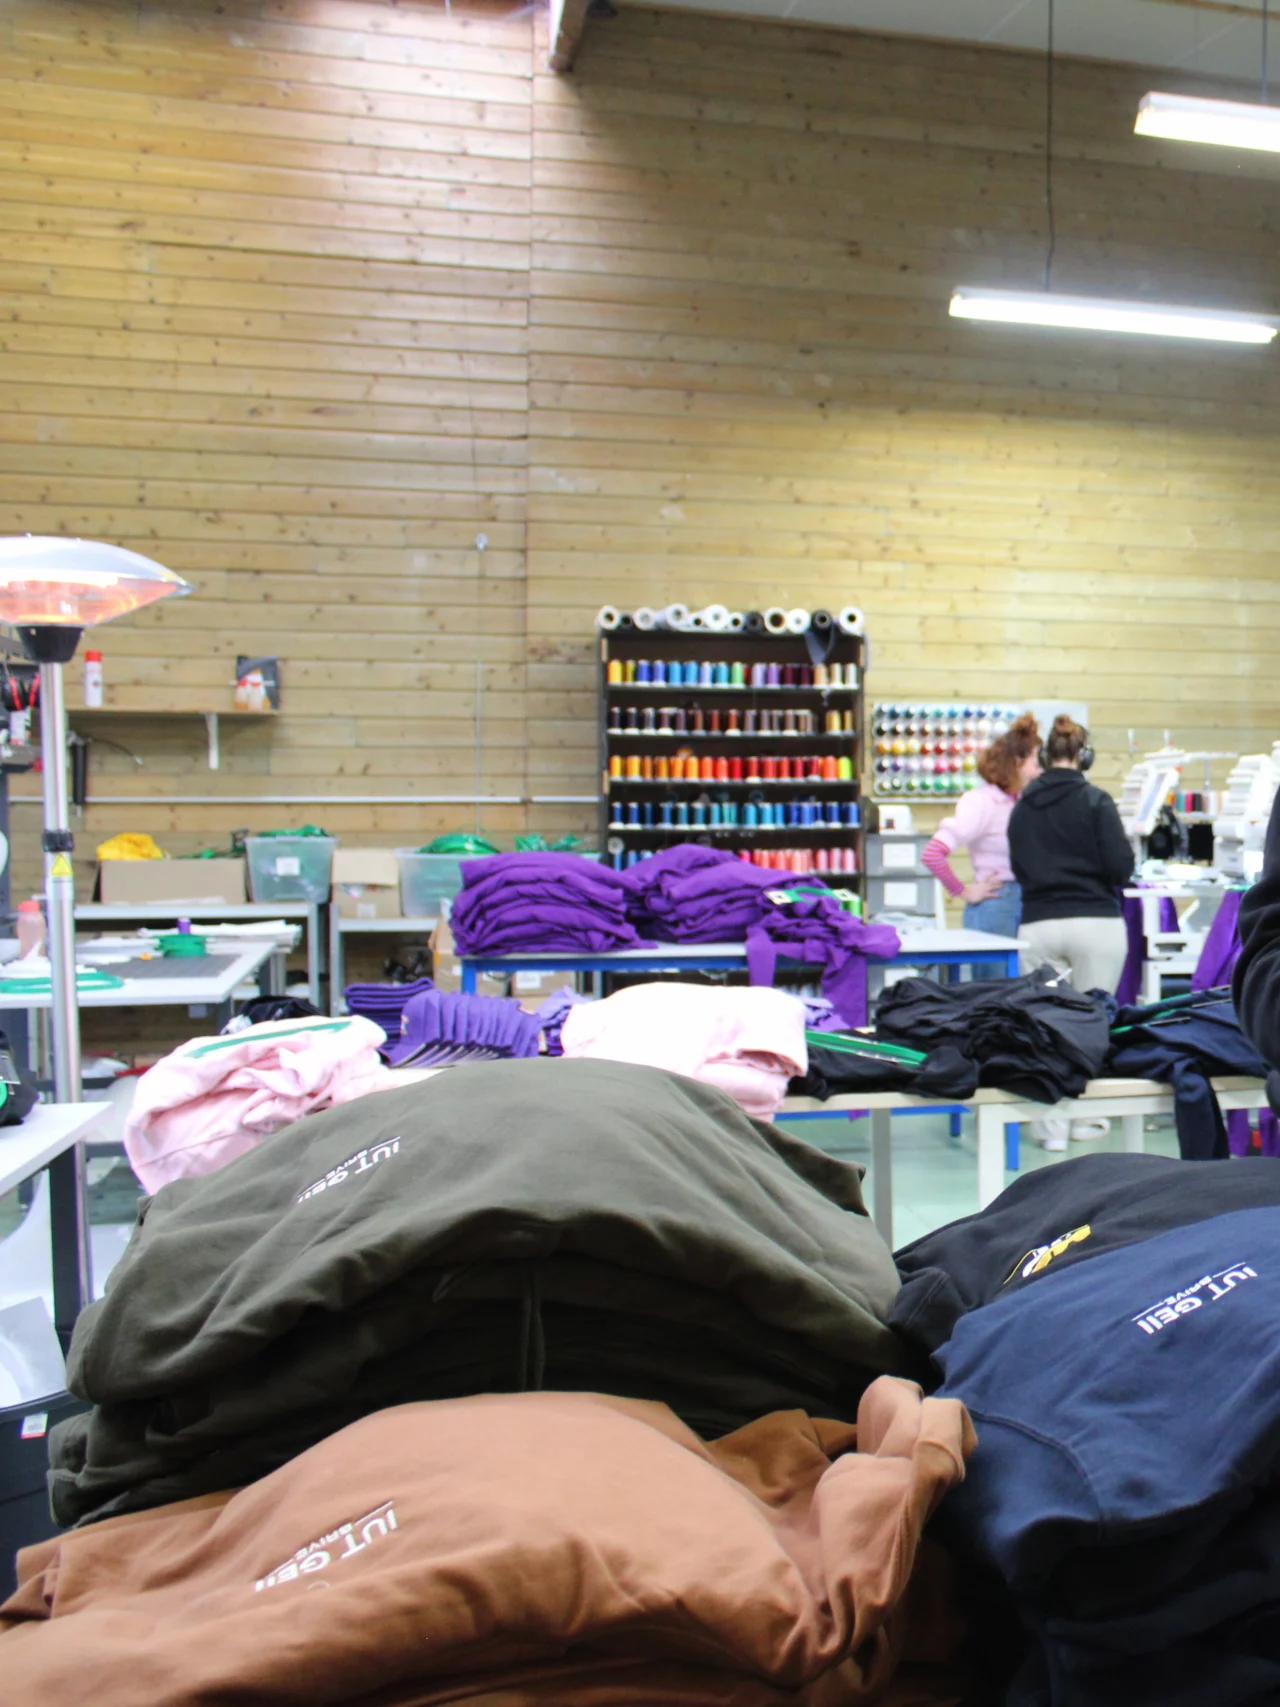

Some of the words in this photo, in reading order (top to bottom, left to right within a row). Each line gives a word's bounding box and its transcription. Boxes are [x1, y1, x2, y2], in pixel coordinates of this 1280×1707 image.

[354, 1140, 400, 1175] IUT
[1163, 1275, 1213, 1306] BRIVE
[1207, 1266, 1259, 1301] IUT
[1136, 1296, 1203, 1335] GEII
[294, 1522, 354, 1561] BRIVE
[340, 1508, 398, 1559] IUT
